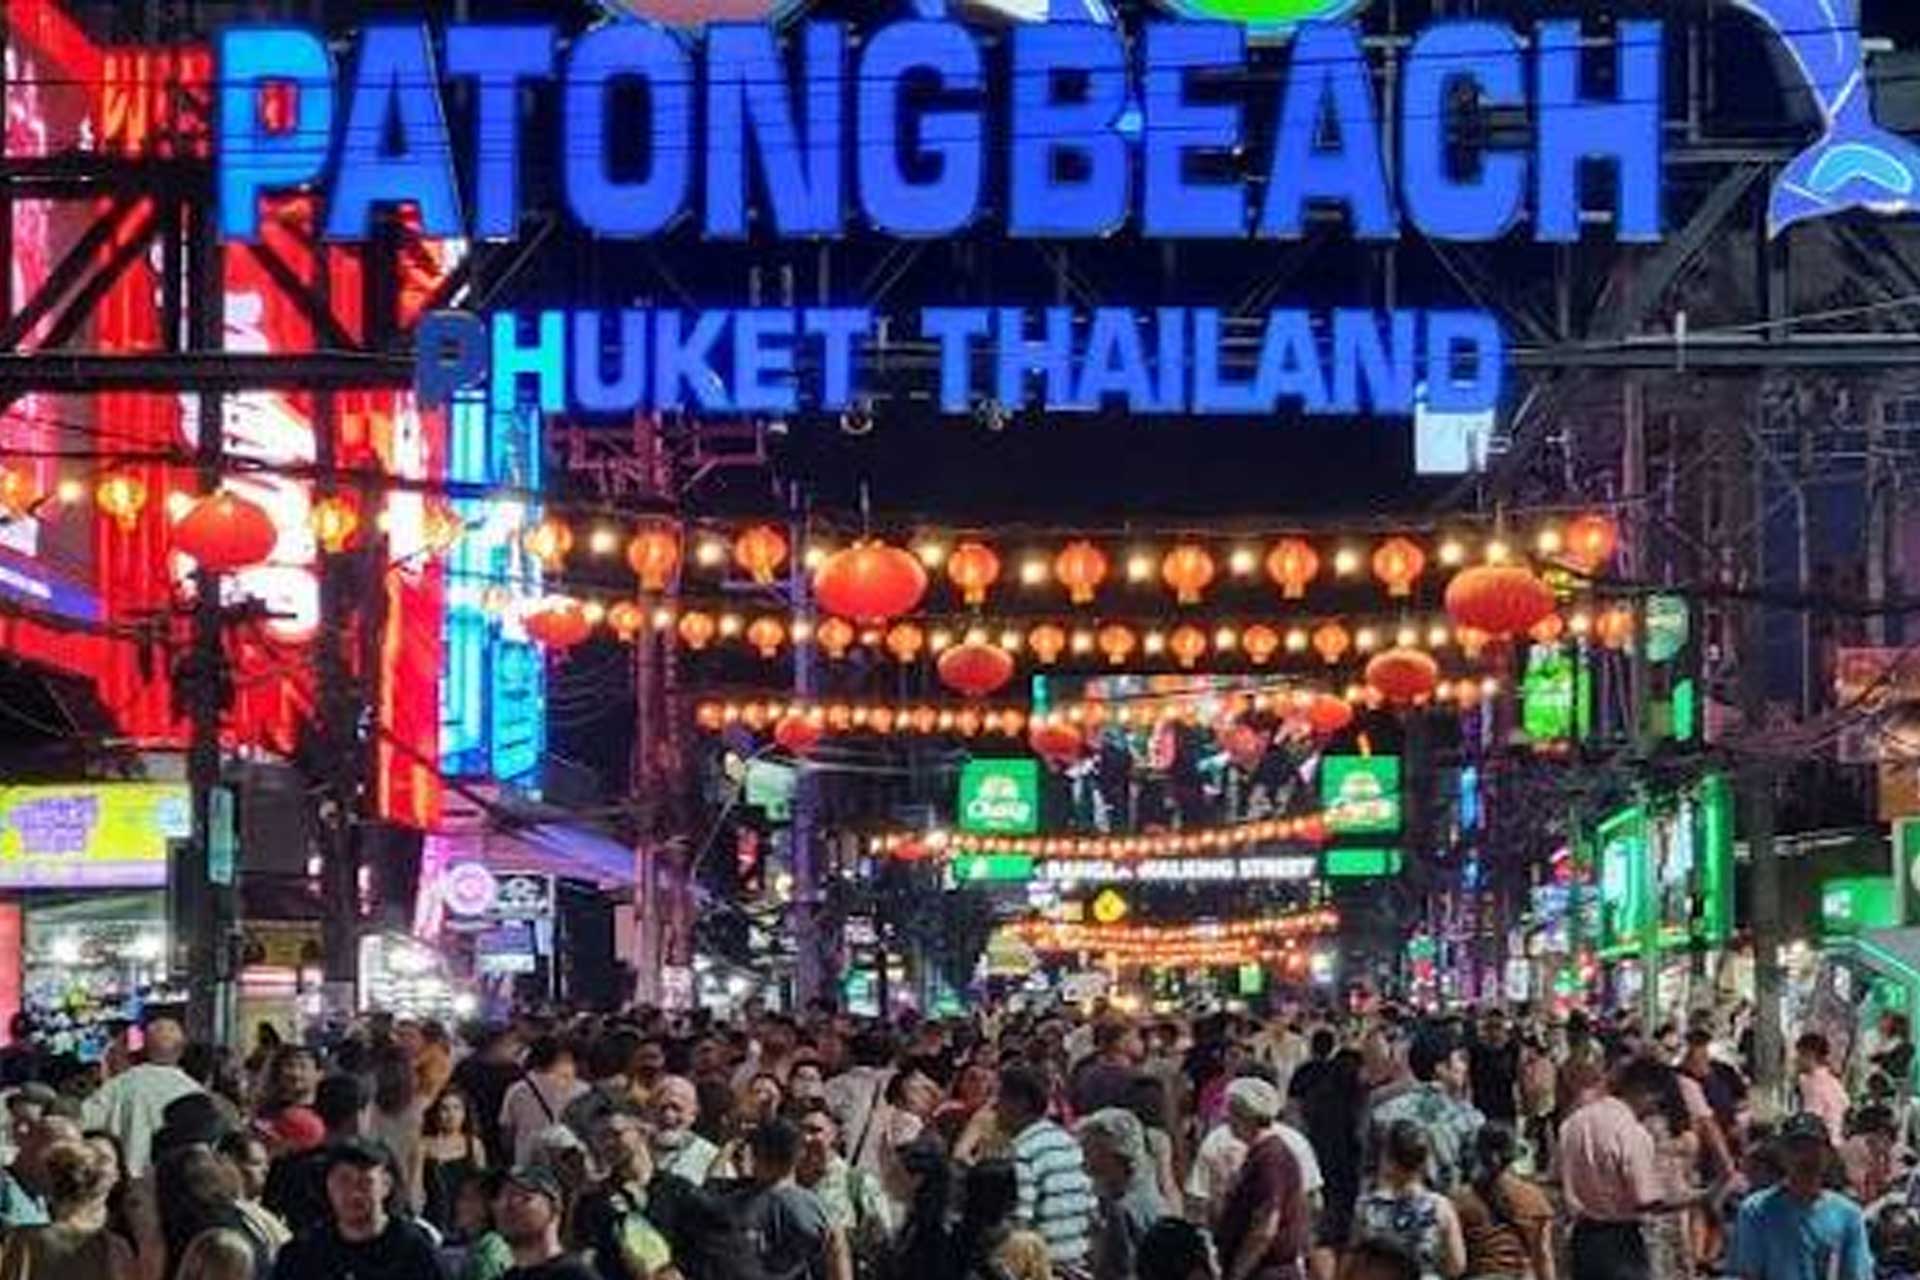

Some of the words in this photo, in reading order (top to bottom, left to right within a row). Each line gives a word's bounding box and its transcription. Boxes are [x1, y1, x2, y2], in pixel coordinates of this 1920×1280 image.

[219, 20, 982, 241] PATONG
[1008, 20, 1662, 242] BEACH
[418, 307, 869, 413] PHUKET
[921, 306, 1504, 413] THAILAND
